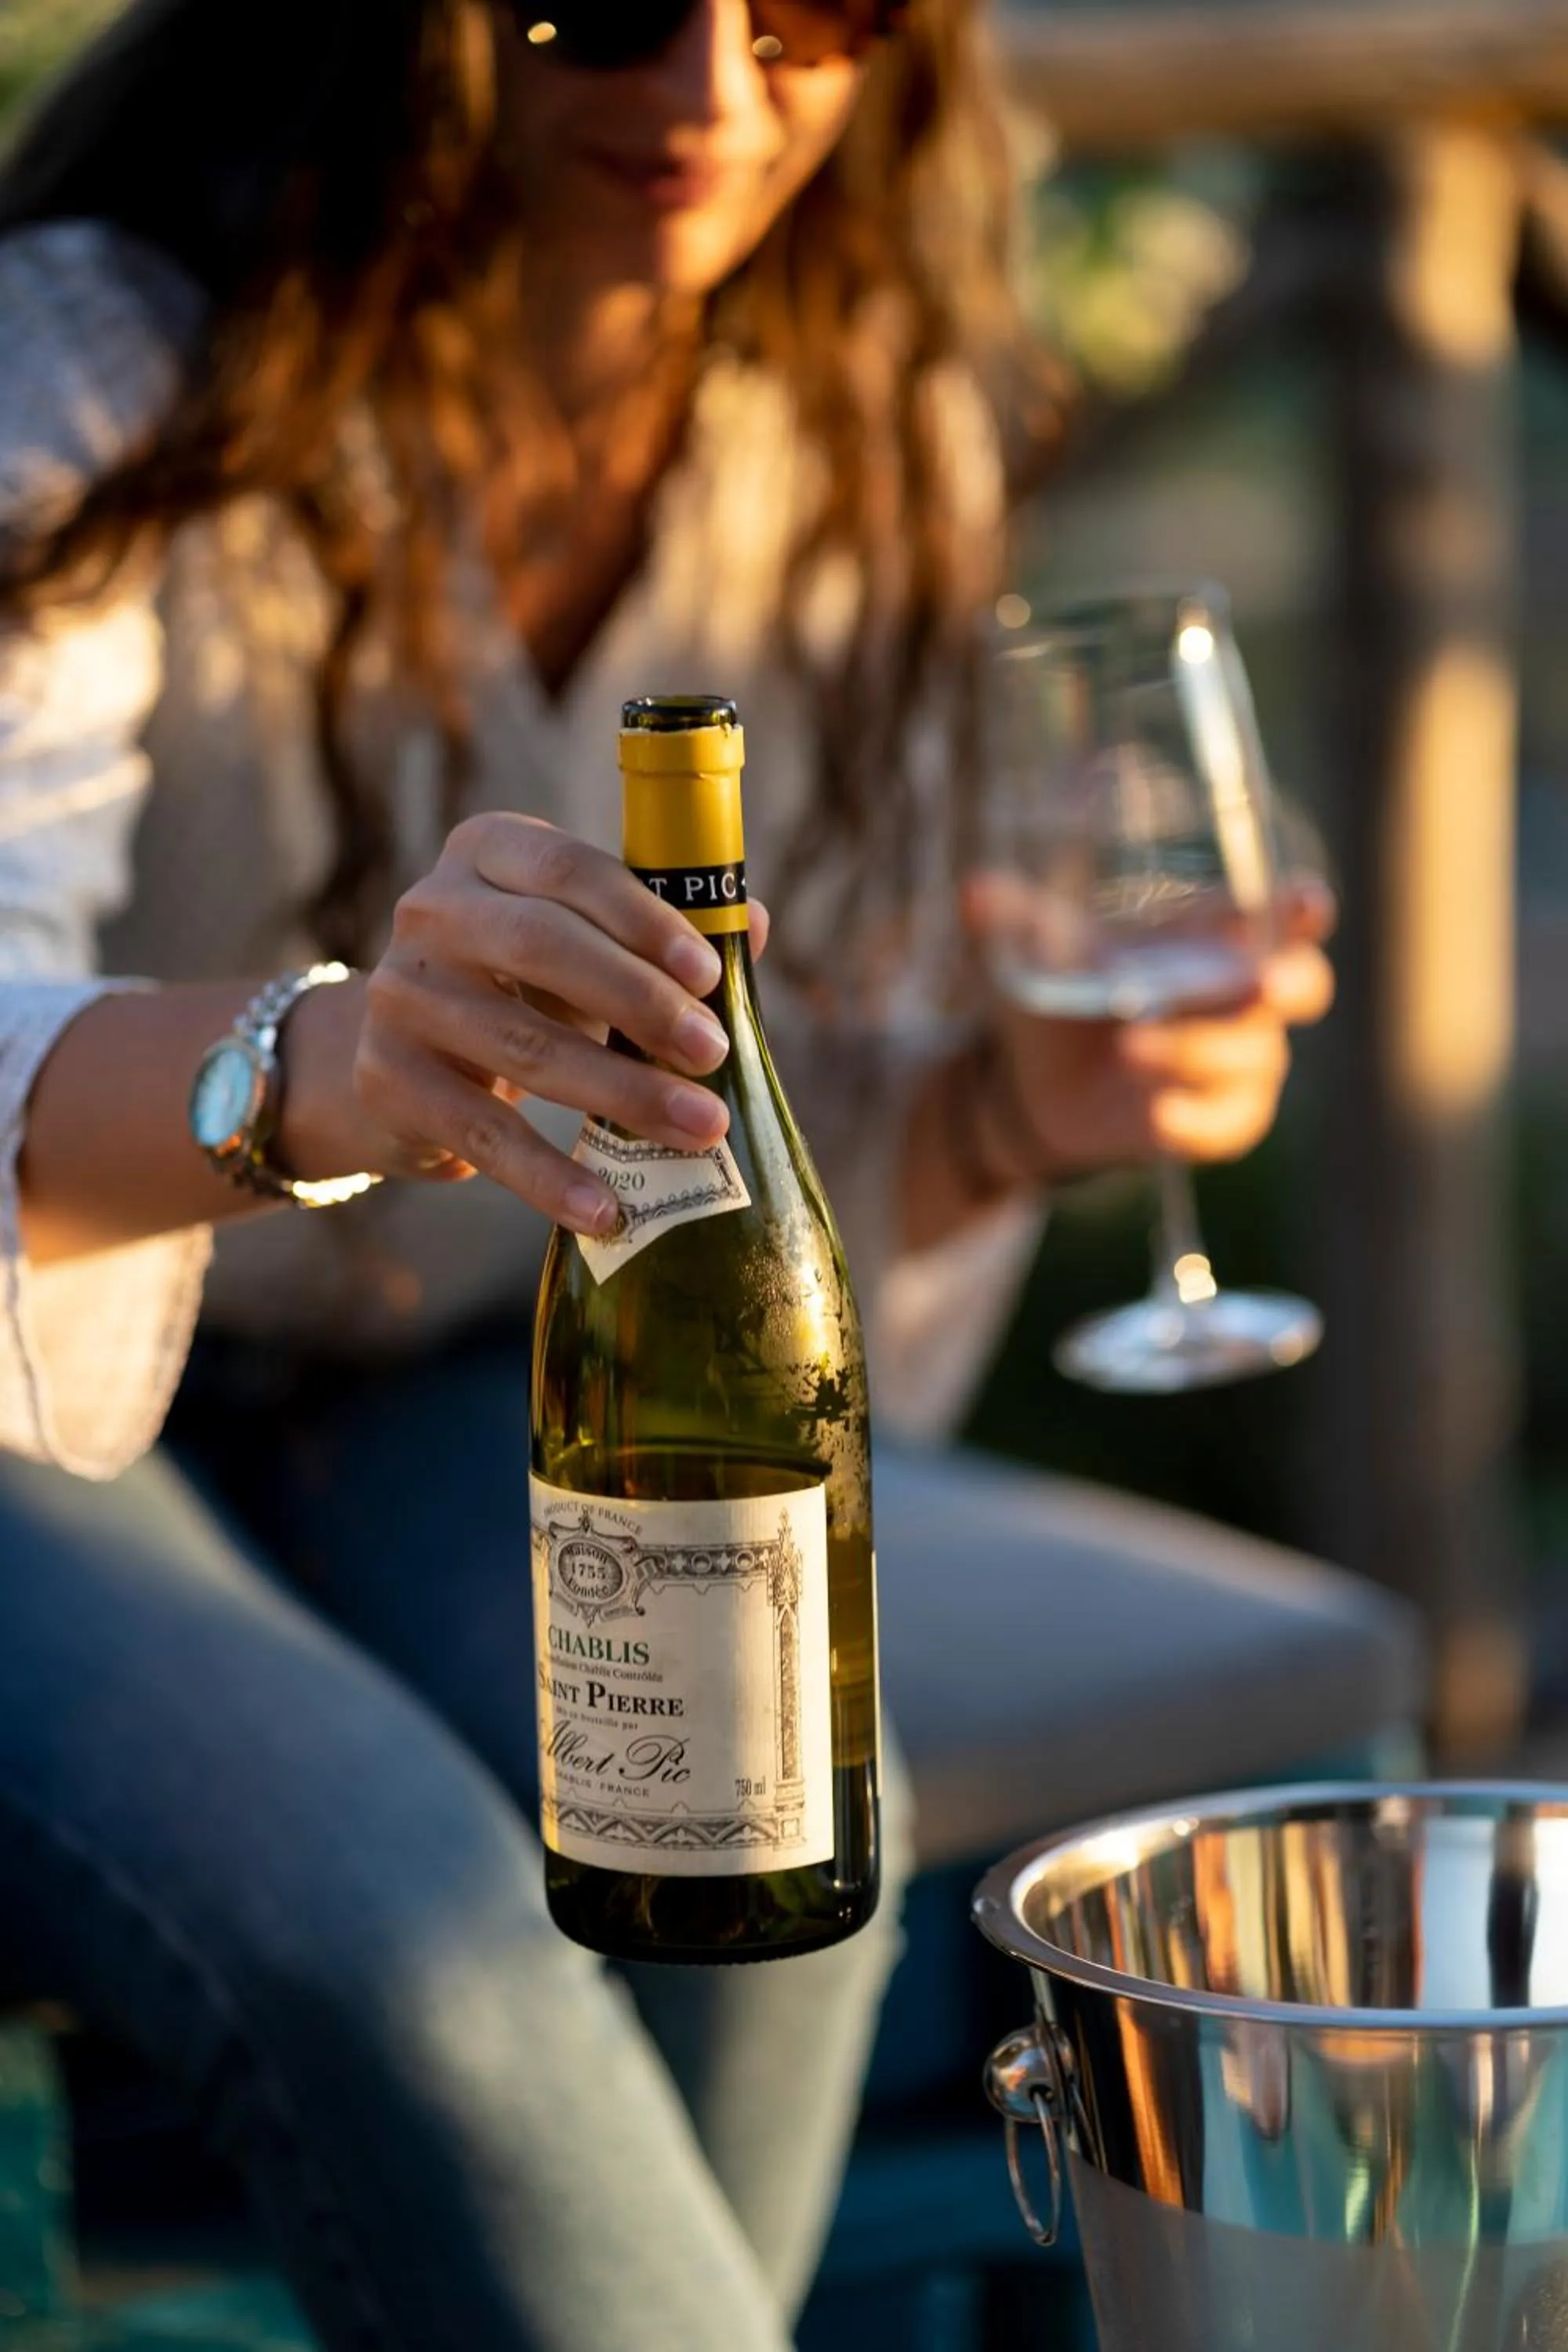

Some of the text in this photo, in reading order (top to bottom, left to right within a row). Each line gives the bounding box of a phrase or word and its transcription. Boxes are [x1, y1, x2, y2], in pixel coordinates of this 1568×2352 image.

[684, 873, 736, 901] PIC
[598, 1507, 643, 1536] FRANCE
[572, 1561, 605, 1580] 1755
[548, 1624, 650, 1666] CHABLIS
[586, 1680, 684, 1717] PIERRE
[619, 1734, 691, 1784] Pic
